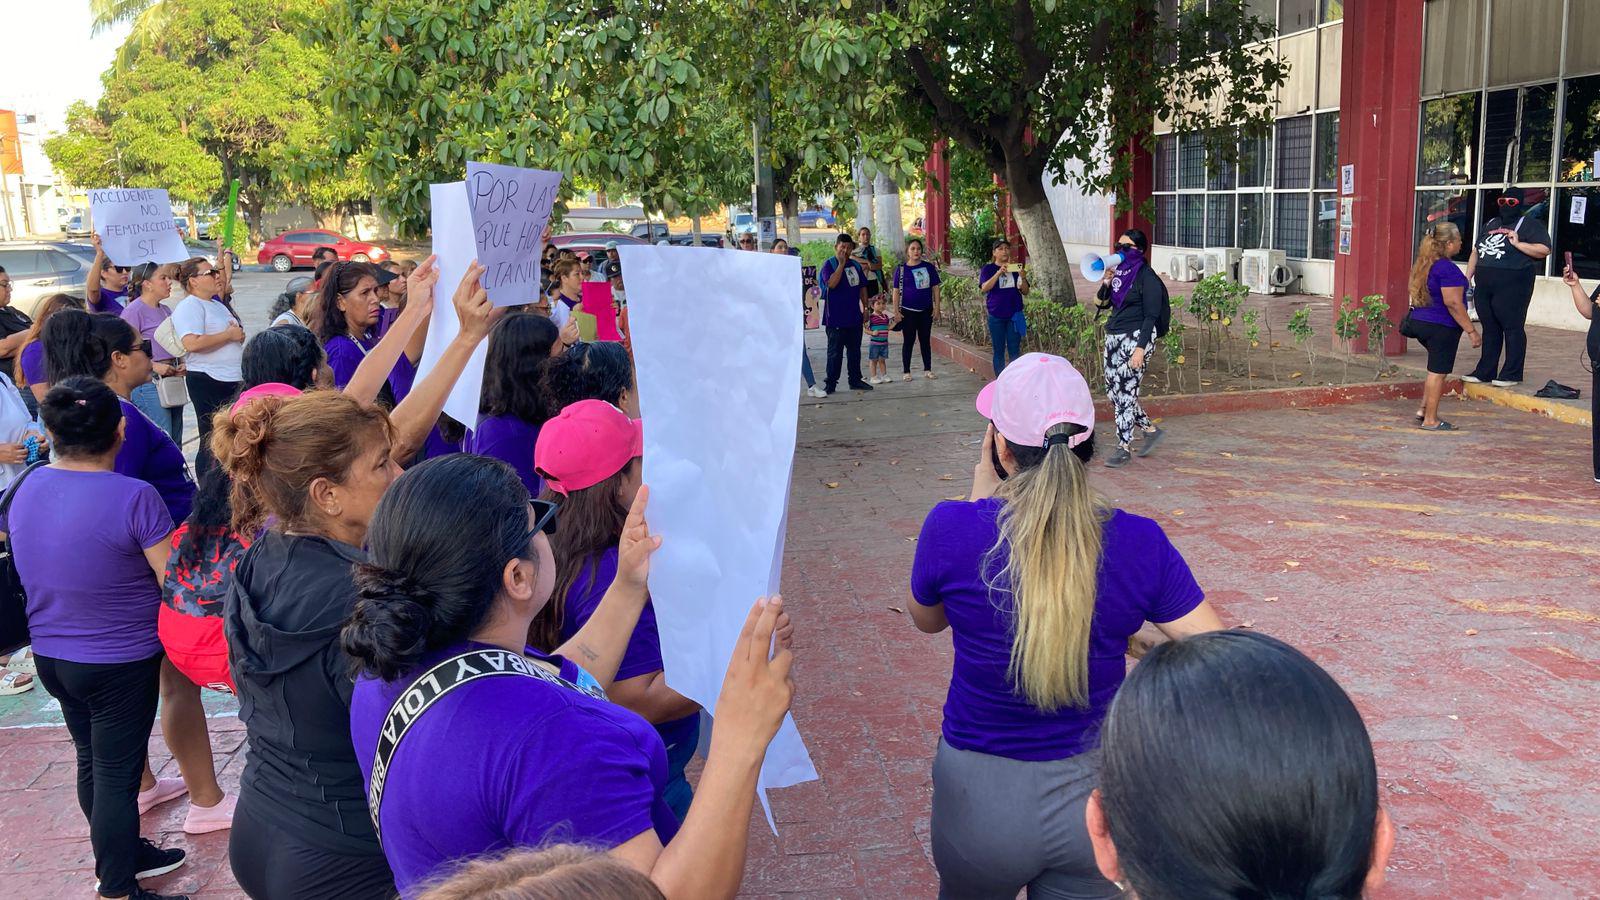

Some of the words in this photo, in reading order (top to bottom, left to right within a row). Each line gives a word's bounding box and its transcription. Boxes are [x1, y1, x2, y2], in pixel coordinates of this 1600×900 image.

[92, 189, 155, 205] ACCIDENTE
[473, 170, 519, 214] POR
[526, 182, 556, 219] LAS
[137, 239, 158, 257] SI
[477, 220, 511, 251] QUE
[455, 658, 482, 682] Y
[383, 673, 442, 745] LOLA
